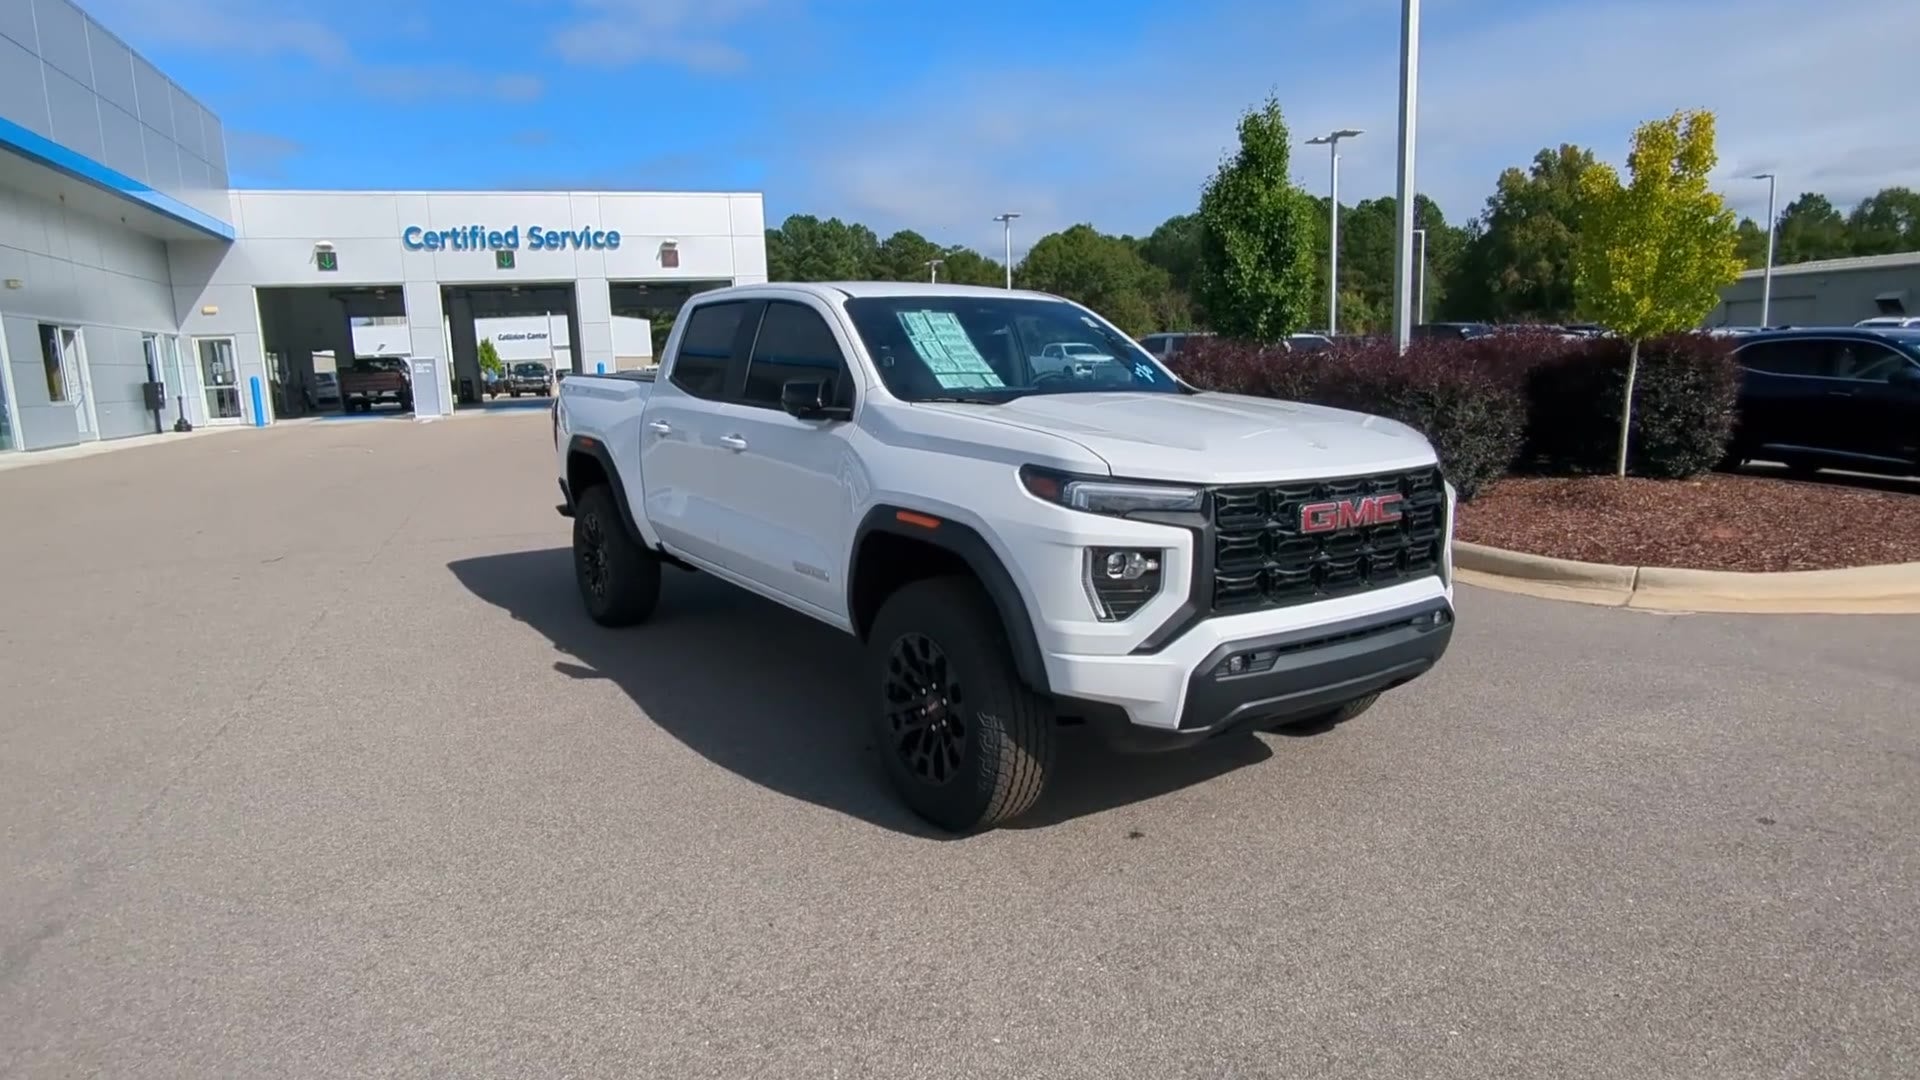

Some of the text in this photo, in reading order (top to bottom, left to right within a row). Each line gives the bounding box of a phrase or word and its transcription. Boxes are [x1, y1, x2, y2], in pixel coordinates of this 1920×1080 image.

[403, 225, 621, 251] Certified Service
[1301, 493, 1403, 533] GMC
